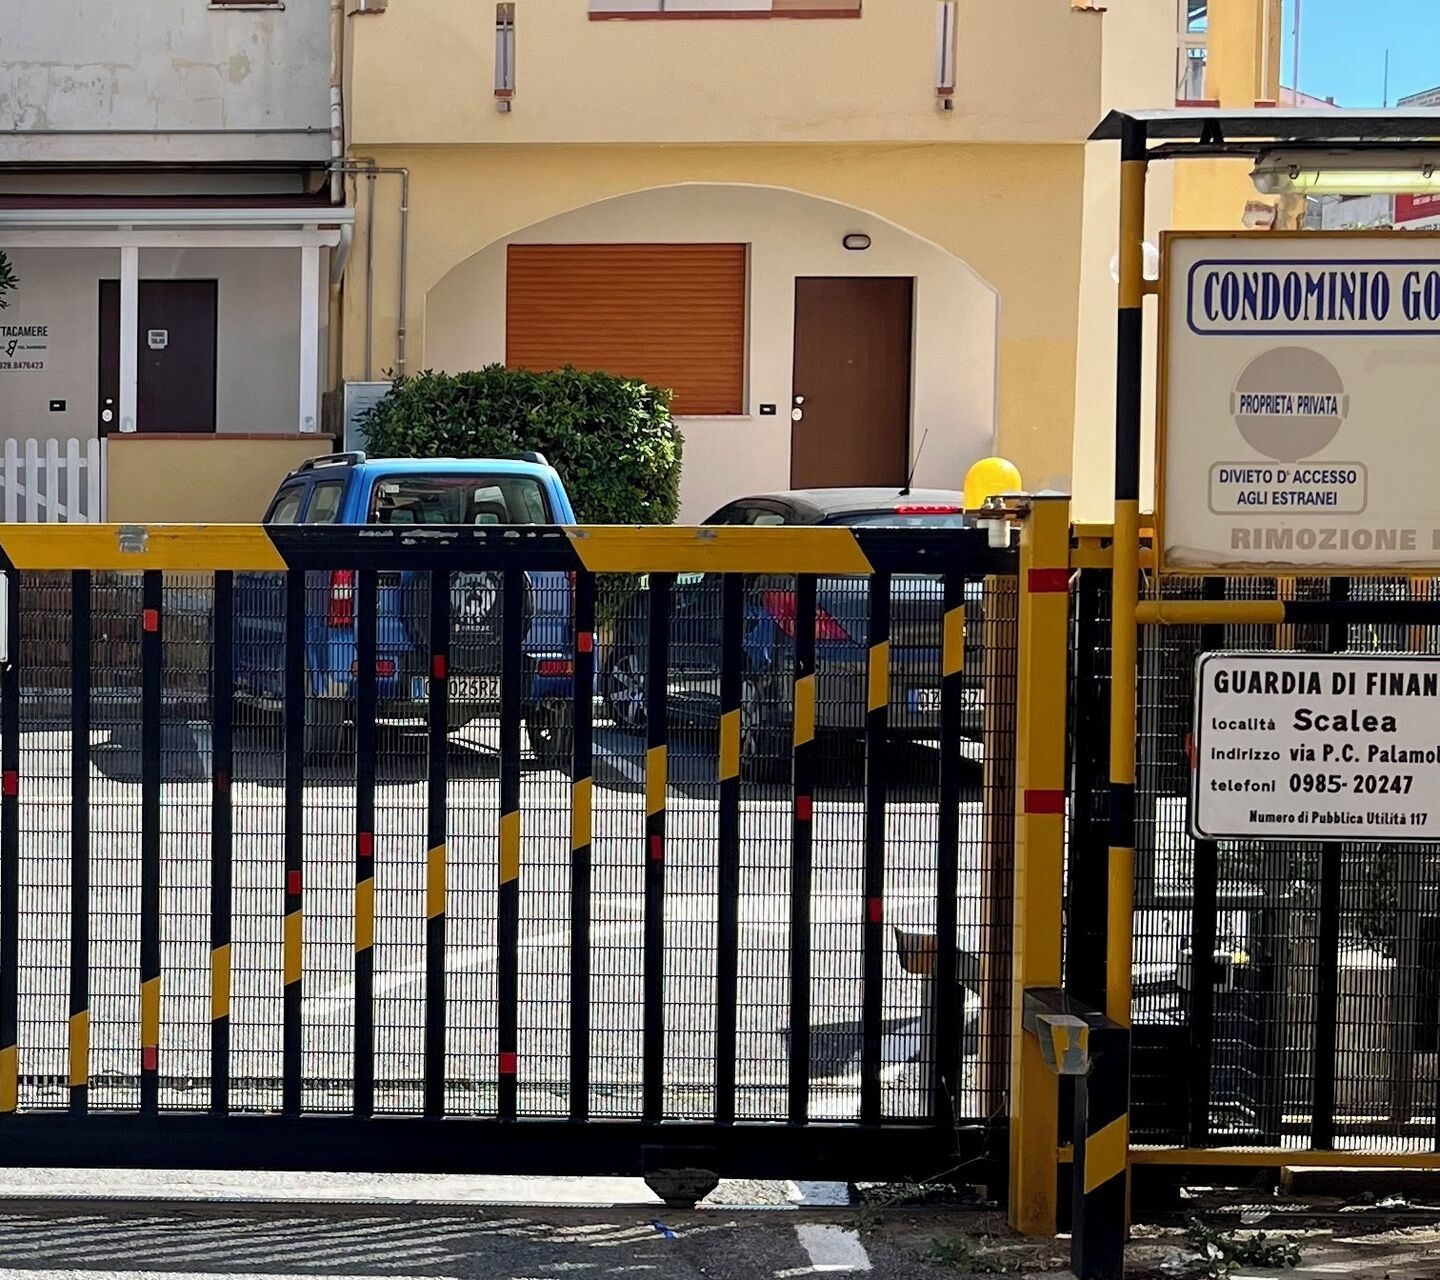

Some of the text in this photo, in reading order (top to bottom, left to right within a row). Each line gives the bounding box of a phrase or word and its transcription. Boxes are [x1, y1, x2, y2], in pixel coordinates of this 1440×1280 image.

[1203, 270, 1440, 321] CONDOMINIO GO
[1297, 395, 1338, 415] PRIVATA
[1219, 469, 1273, 484] DIVIETO
[1237, 491, 1338, 506] AGLI ESTRANEI
[1230, 528, 1417, 550] RIMOZIONE
[1213, 670, 1438, 696] GUARDIA DI FINAN
[1211, 708, 1398, 733] località Scalea
[1289, 743, 1316, 762] via
[1323, 744, 1360, 763] P.C.
[1210, 778, 1276, 792] telefoni
[1353, 775, 1413, 794] 20247
[1249, 810, 1428, 826] Numero di Pubblica Utilità 117
